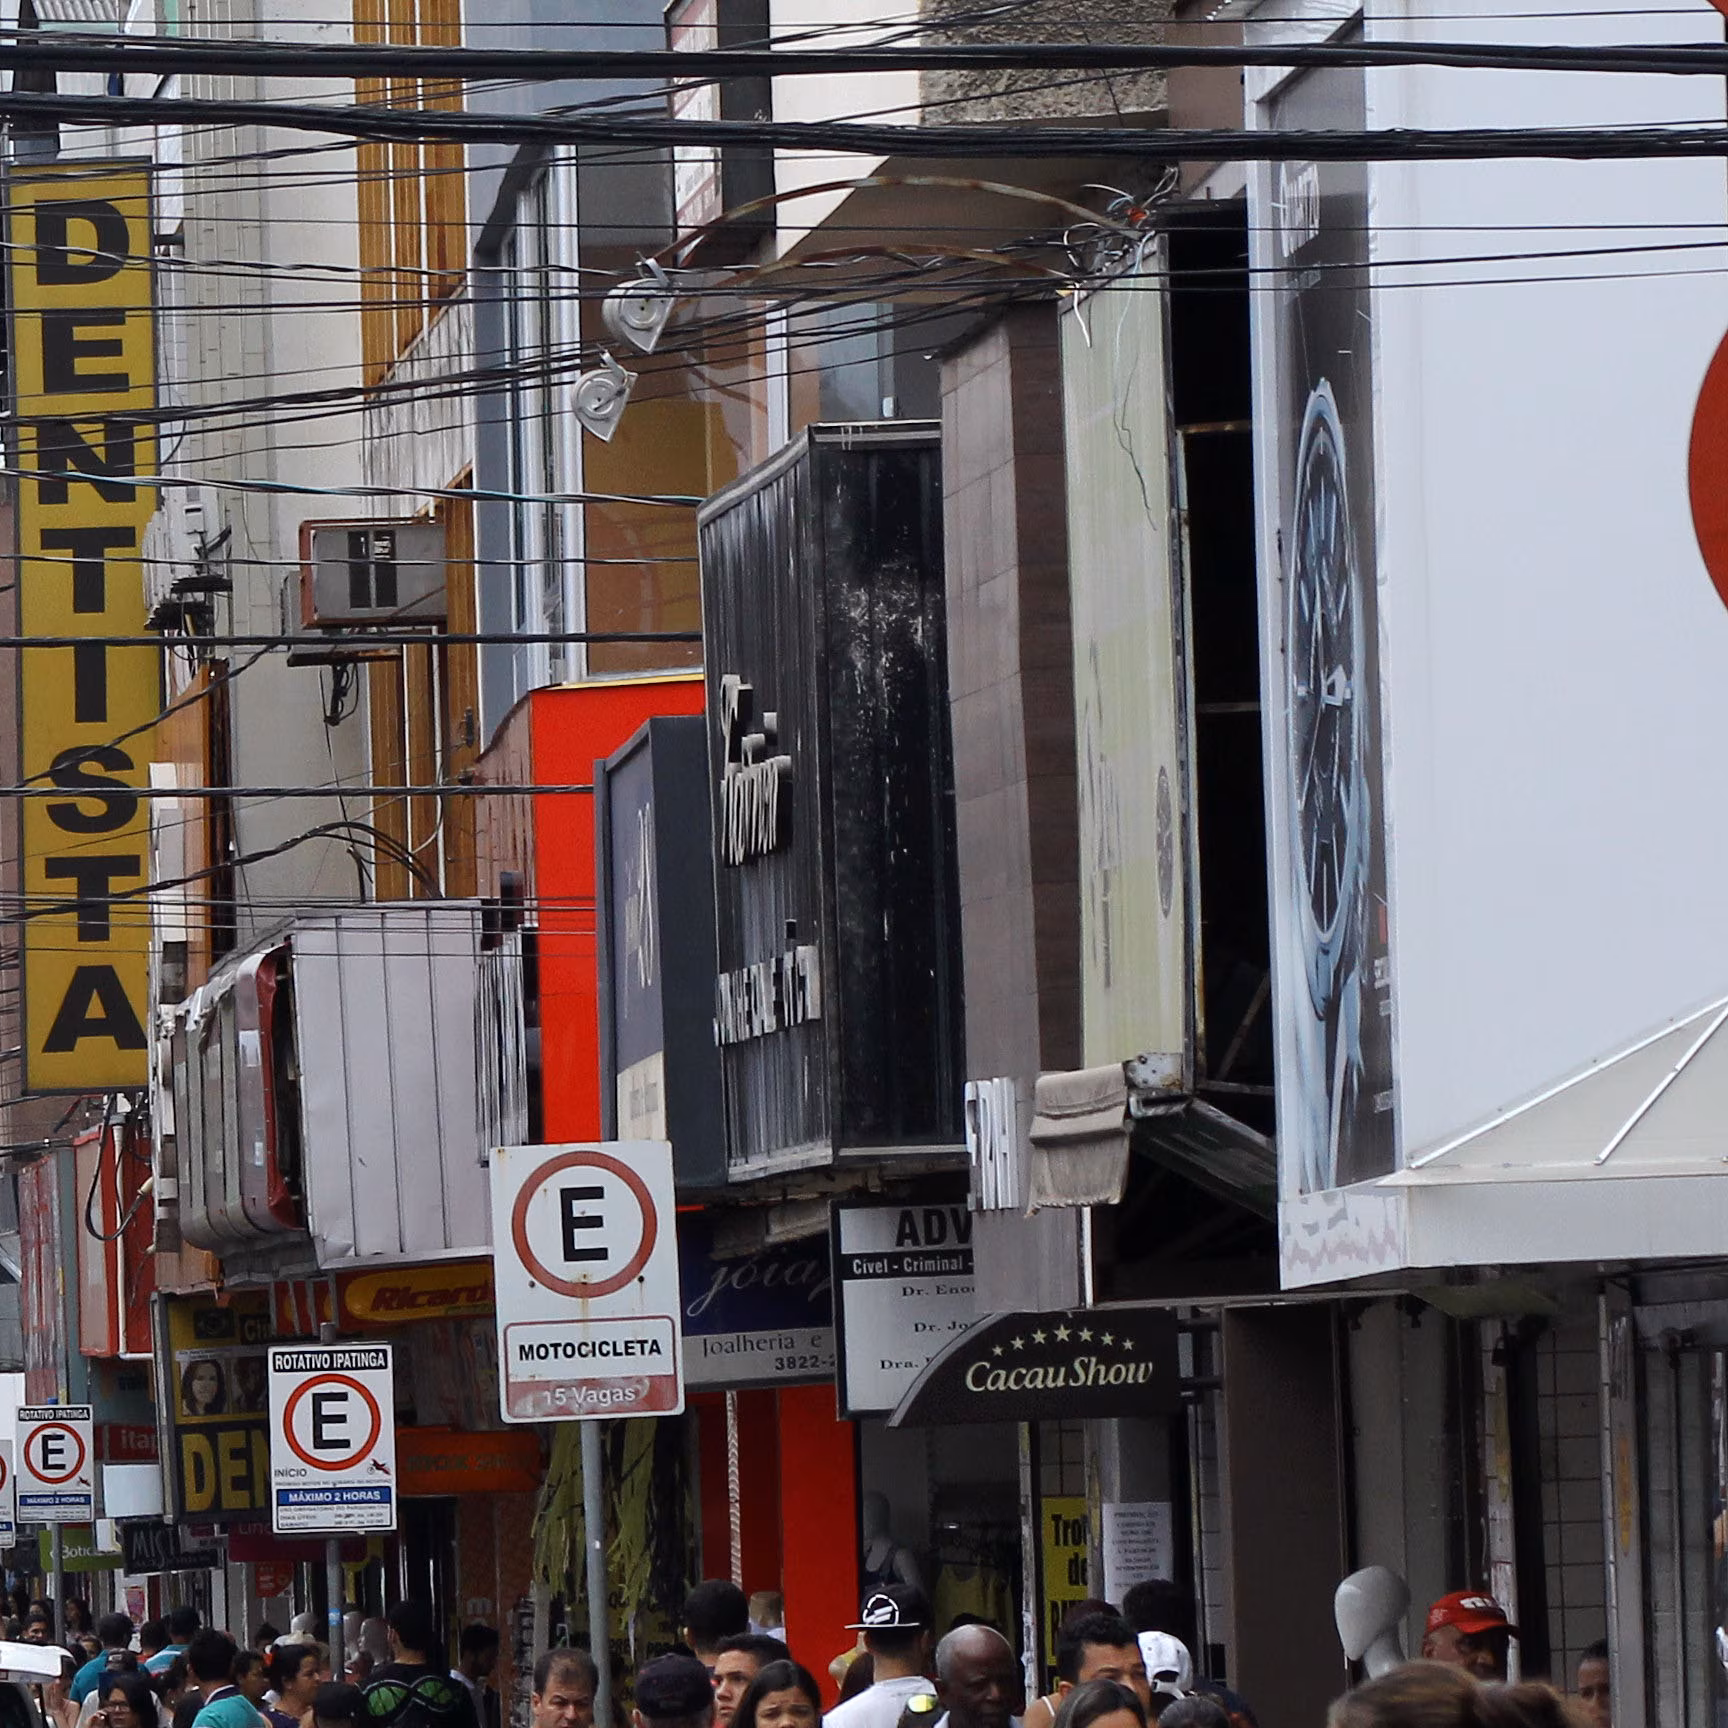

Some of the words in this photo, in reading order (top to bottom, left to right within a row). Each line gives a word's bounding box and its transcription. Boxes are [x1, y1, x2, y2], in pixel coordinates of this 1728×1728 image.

[34, 199, 148, 1054] DENTISTA
[560, 1186, 609, 1262] E
[852, 1257, 889, 1274] Cível
[903, 1256, 964, 1273] Criminal
[519, 1339, 662, 1362] MOTOCICLETA
[702, 1332, 796, 1358] Joalheria
[811, 1333, 822, 1346] e
[275, 1352, 330, 1371] ROTATIVO
[332, 1350, 386, 1370] IPATINGA
[966, 1361, 1067, 1393] Cacau
[1069, 1356, 1154, 1387] Show
[573, 1385, 636, 1407] Vagas
[19, 1410, 54, 1421] ROTATIVO
[56, 1409, 90, 1420] IPATINGA
[312, 1392, 351, 1450] E
[42, 1435, 66, 1470] E
[288, 1490, 333, 1503] MÁXIMO
[334, 1493, 341, 1502] 2
[343, 1490, 382, 1502] HORAS
